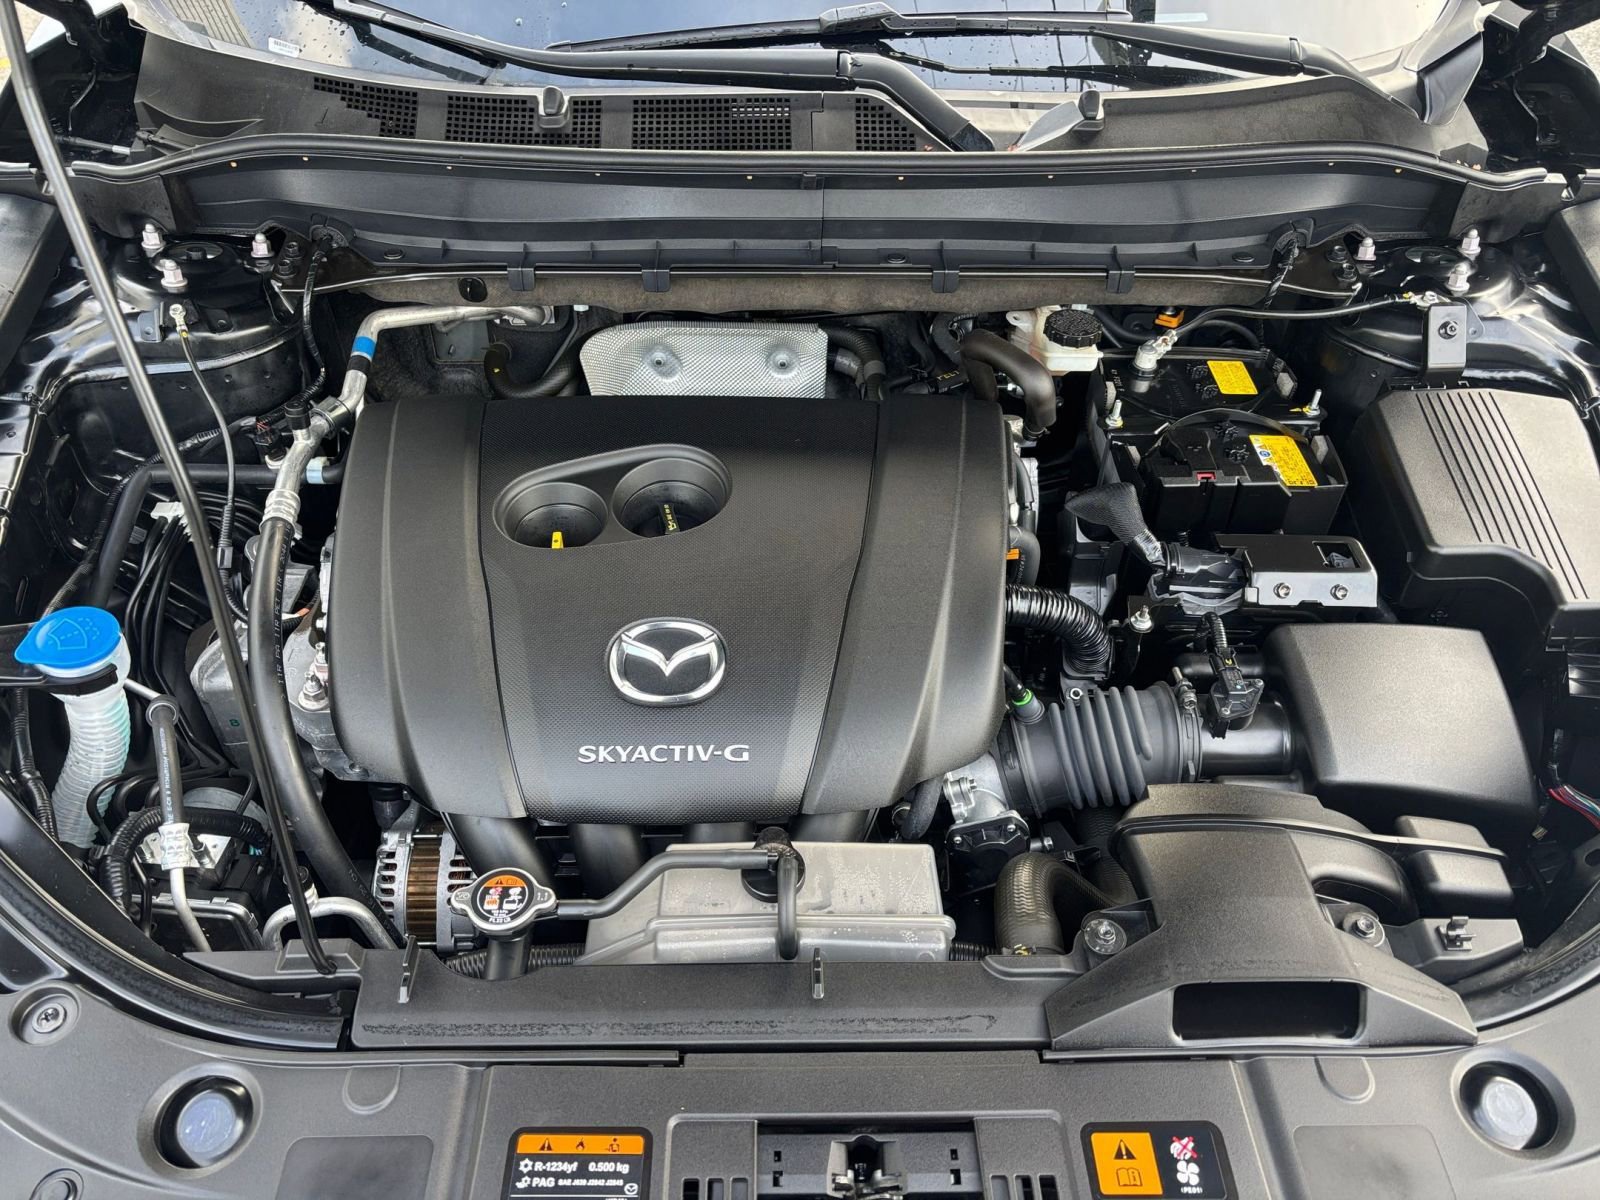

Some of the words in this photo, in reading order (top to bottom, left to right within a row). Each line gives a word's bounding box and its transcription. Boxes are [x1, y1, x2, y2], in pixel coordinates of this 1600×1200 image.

[577, 744, 750, 763] SKYACTIV-G
[534, 1161, 578, 1173] R-1234yf
[588, 1161, 615, 1172] 0.500
[616, 1162, 630, 1174] kg
[532, 1176, 556, 1187] PAG
